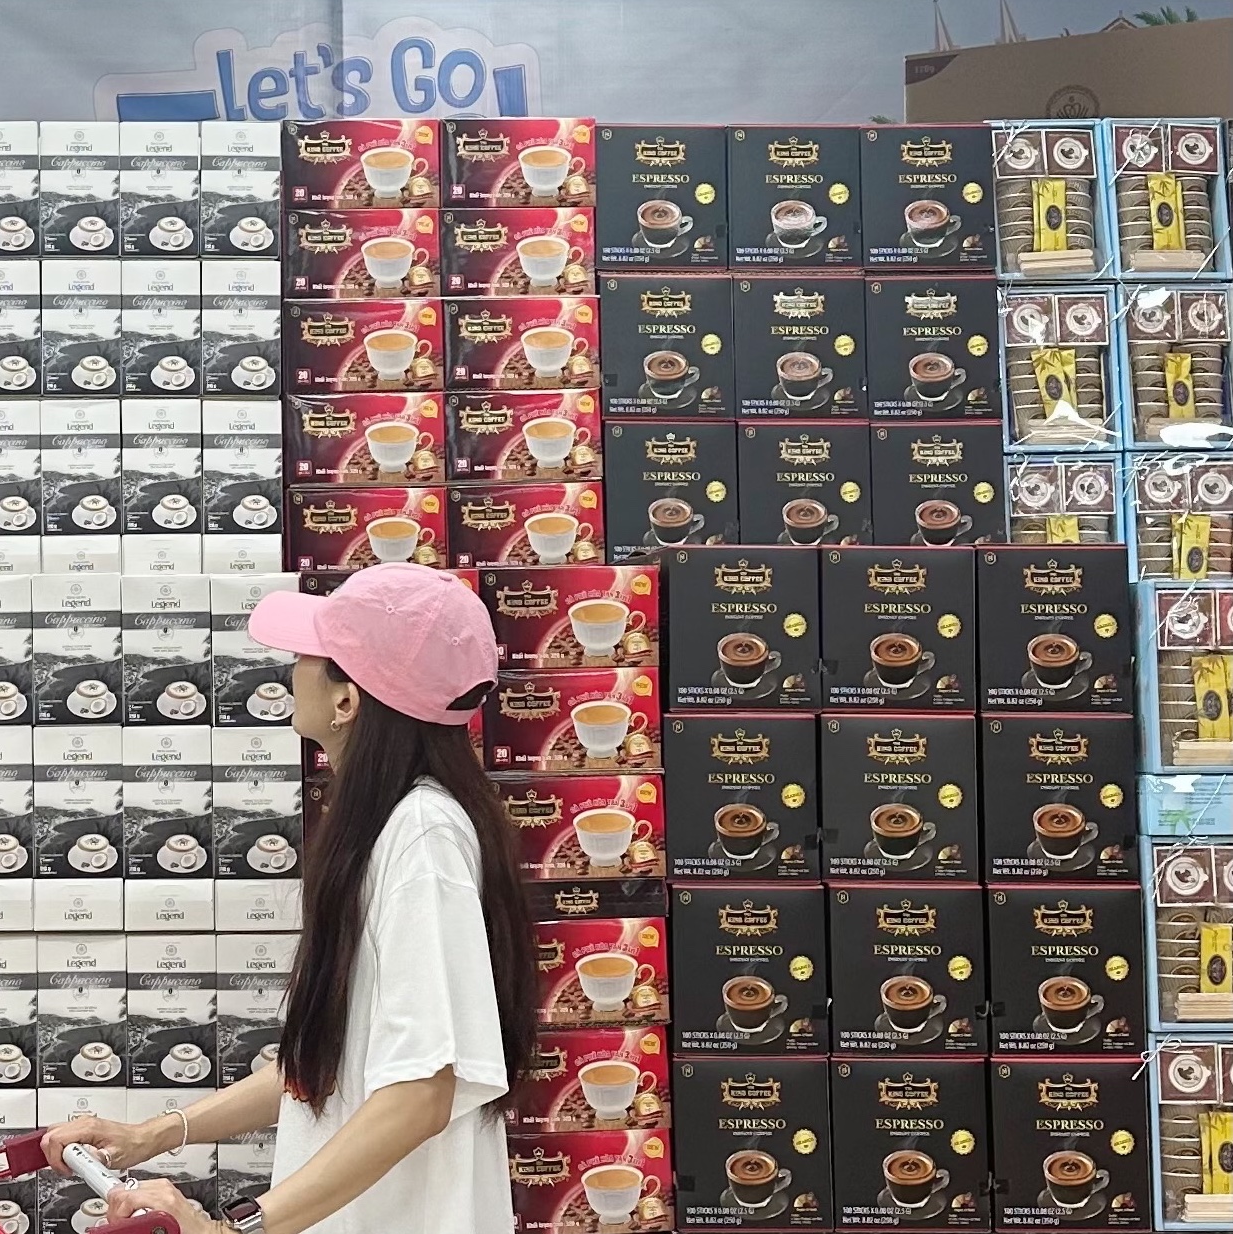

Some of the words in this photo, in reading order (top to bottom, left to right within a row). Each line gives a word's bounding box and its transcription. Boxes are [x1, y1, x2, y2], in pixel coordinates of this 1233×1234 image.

[216, 43, 373, 120] Let's
[391, 36, 487, 113] Go
[630, 172, 690, 184] ESPRESSO
[897, 172, 957, 184] ESPRESSO
[131, 295, 187, 310] Cappuccino
[770, 324, 830, 336] ESPRESSO
[51, 434, 107, 449] Cappuccino
[641, 470, 701, 482] ESPRESSO
[710, 601, 777, 614] ESPRESSO
[1020, 602, 1087, 615] ESPRESSO
[44, 611, 107, 628] Cappuccino
[862, 771, 933, 785] ESPRESSO
[714, 943, 785, 957] ESPRESSO
[1029, 943, 1100, 957] ESPRESSO
[155, 959, 188, 971] Legend
[49, 972, 112, 989] Cappuccino
[874, 1117, 945, 1131] ESPRESSO
